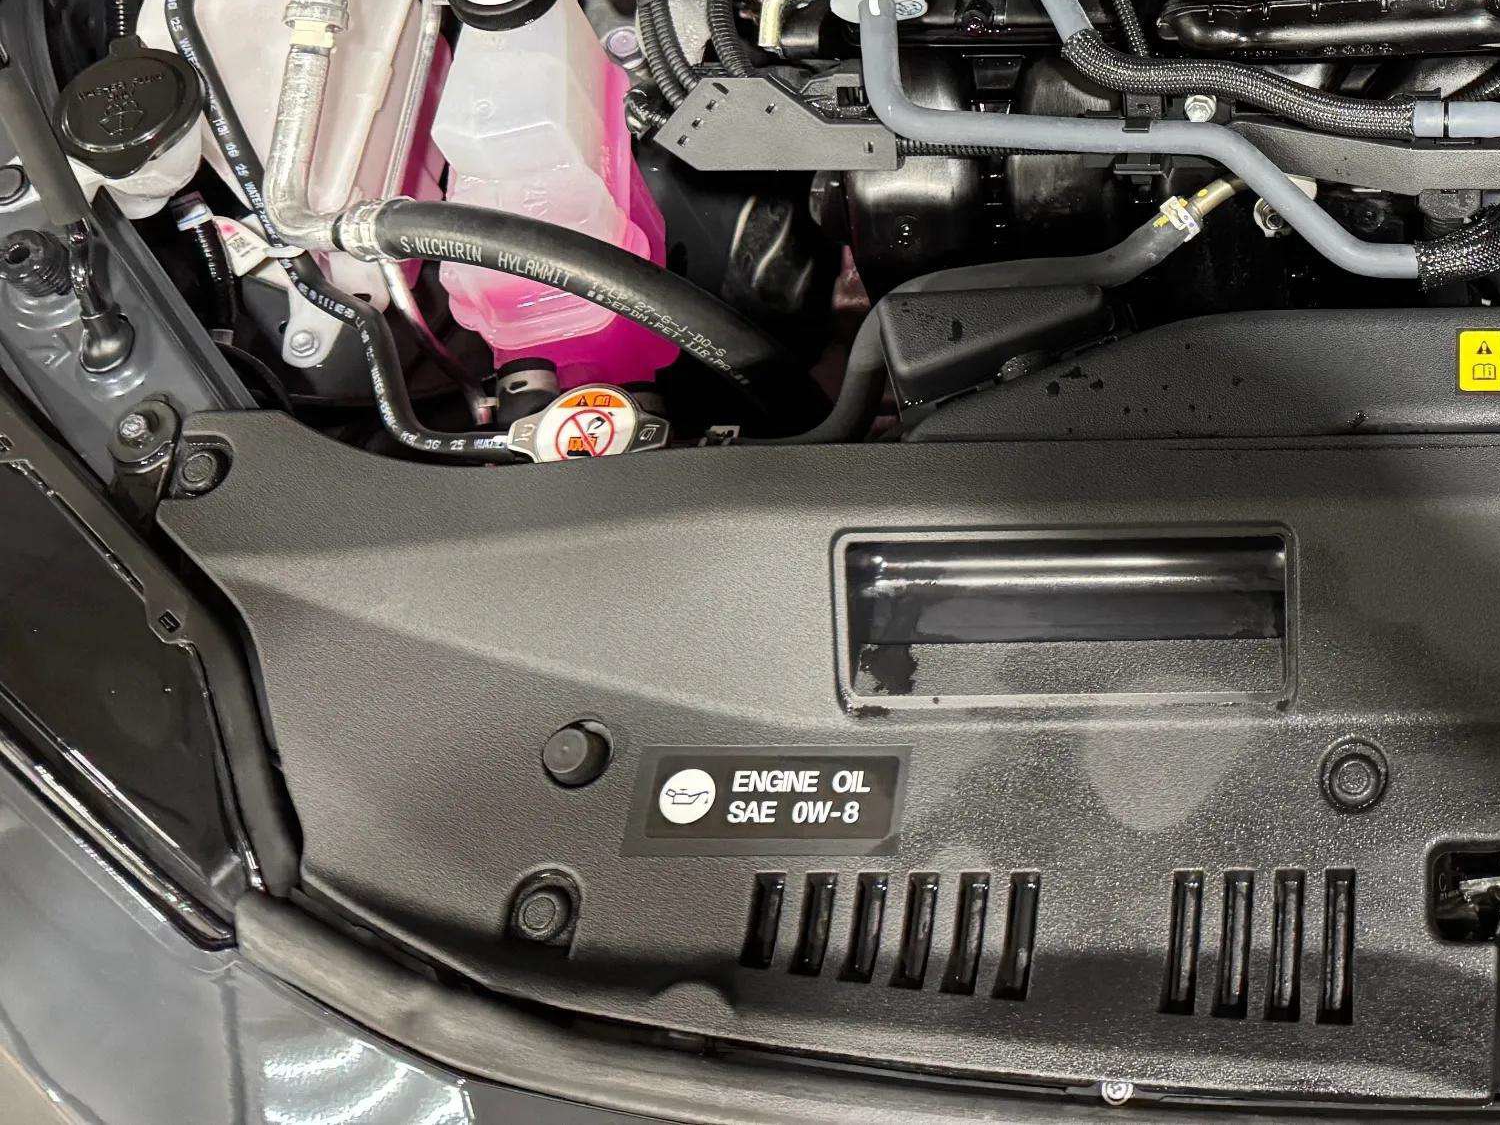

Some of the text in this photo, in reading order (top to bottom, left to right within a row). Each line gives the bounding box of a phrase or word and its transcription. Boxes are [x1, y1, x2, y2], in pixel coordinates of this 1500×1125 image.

[244, 181, 264, 210] WATER
[450, 439, 466, 450] 25
[732, 770, 871, 793] ENGINE OIL
[727, 800, 860, 824] SAE 0W-8
